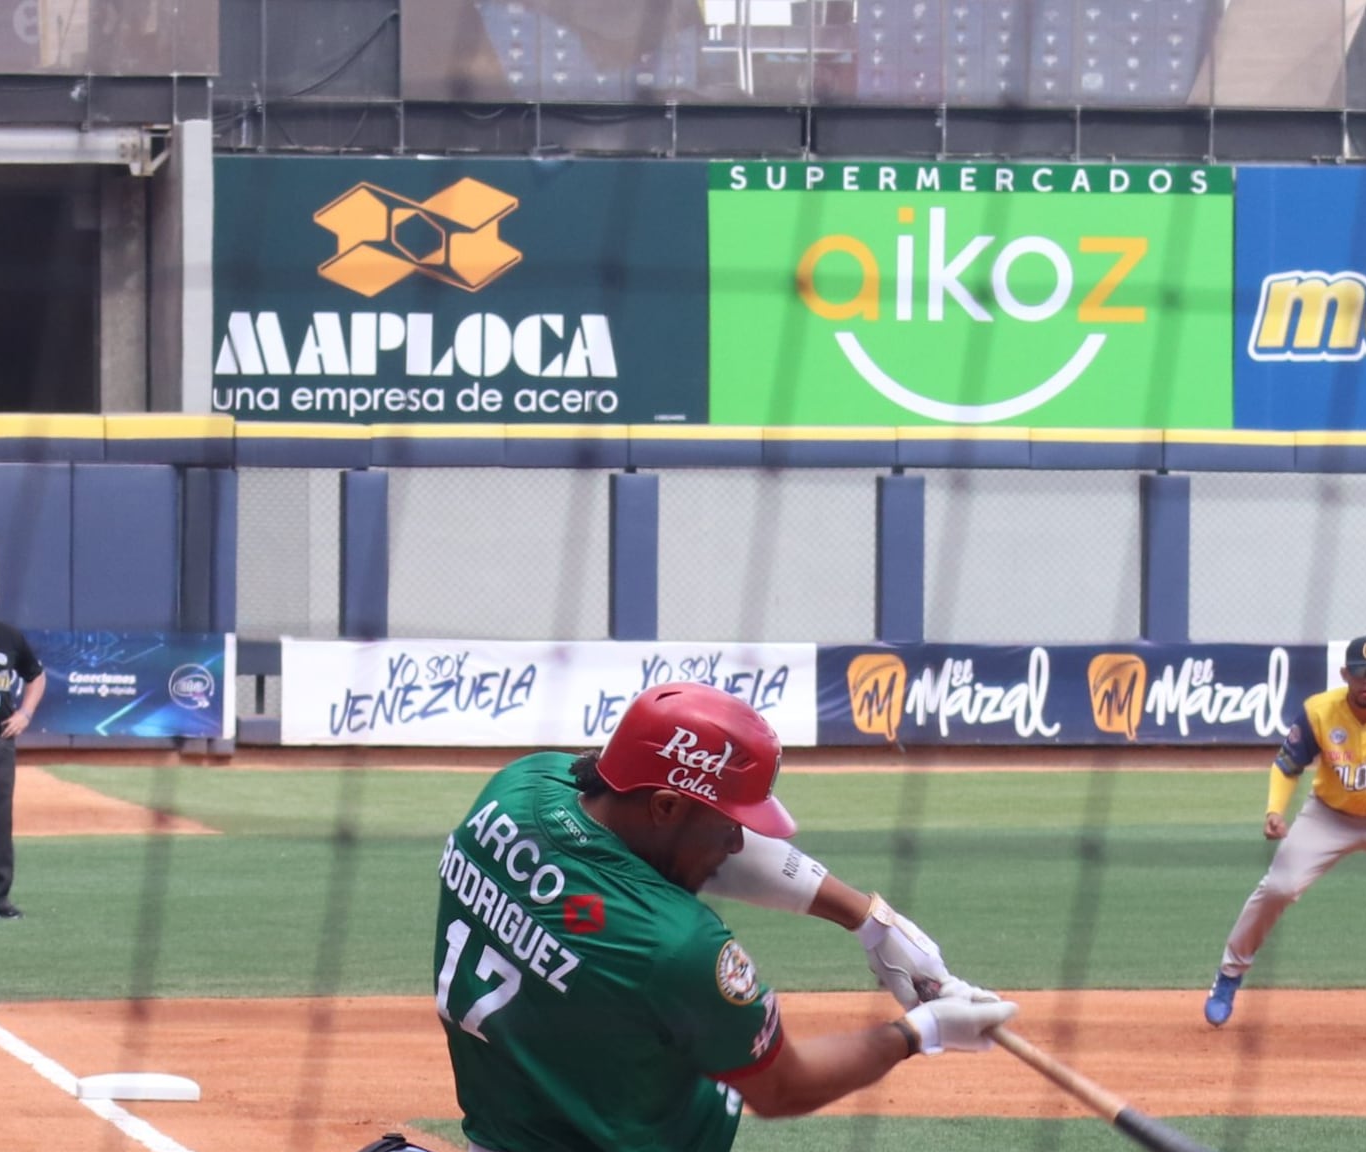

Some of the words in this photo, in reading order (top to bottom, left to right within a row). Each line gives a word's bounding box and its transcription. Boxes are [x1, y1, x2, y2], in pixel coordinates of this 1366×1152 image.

[731, 166, 1208, 194] SUPERMERCADOS
[795, 206, 1148, 323] aikoz
[215, 311, 618, 378] MAPLOCA
[213, 388, 280, 412] una
[292, 387, 444, 417] empresa
[456, 382, 503, 412] de
[514, 387, 619, 414] acero
[329, 664, 538, 736] VENEZUELA
[389, 655, 418, 690] YO
[426, 652, 468, 682] SOY
[642, 654, 672, 690] YO
[679, 652, 722, 682] SOY
[951, 658, 973, 687] El
[1191, 658, 1213, 687] El
[583, 666, 789, 737] VEELA
[658, 726, 733, 779] Red
[467, 800, 565, 905] ARCO
[439, 833, 581, 994] RODRIGUEZ
[438, 918, 523, 1043] 17
